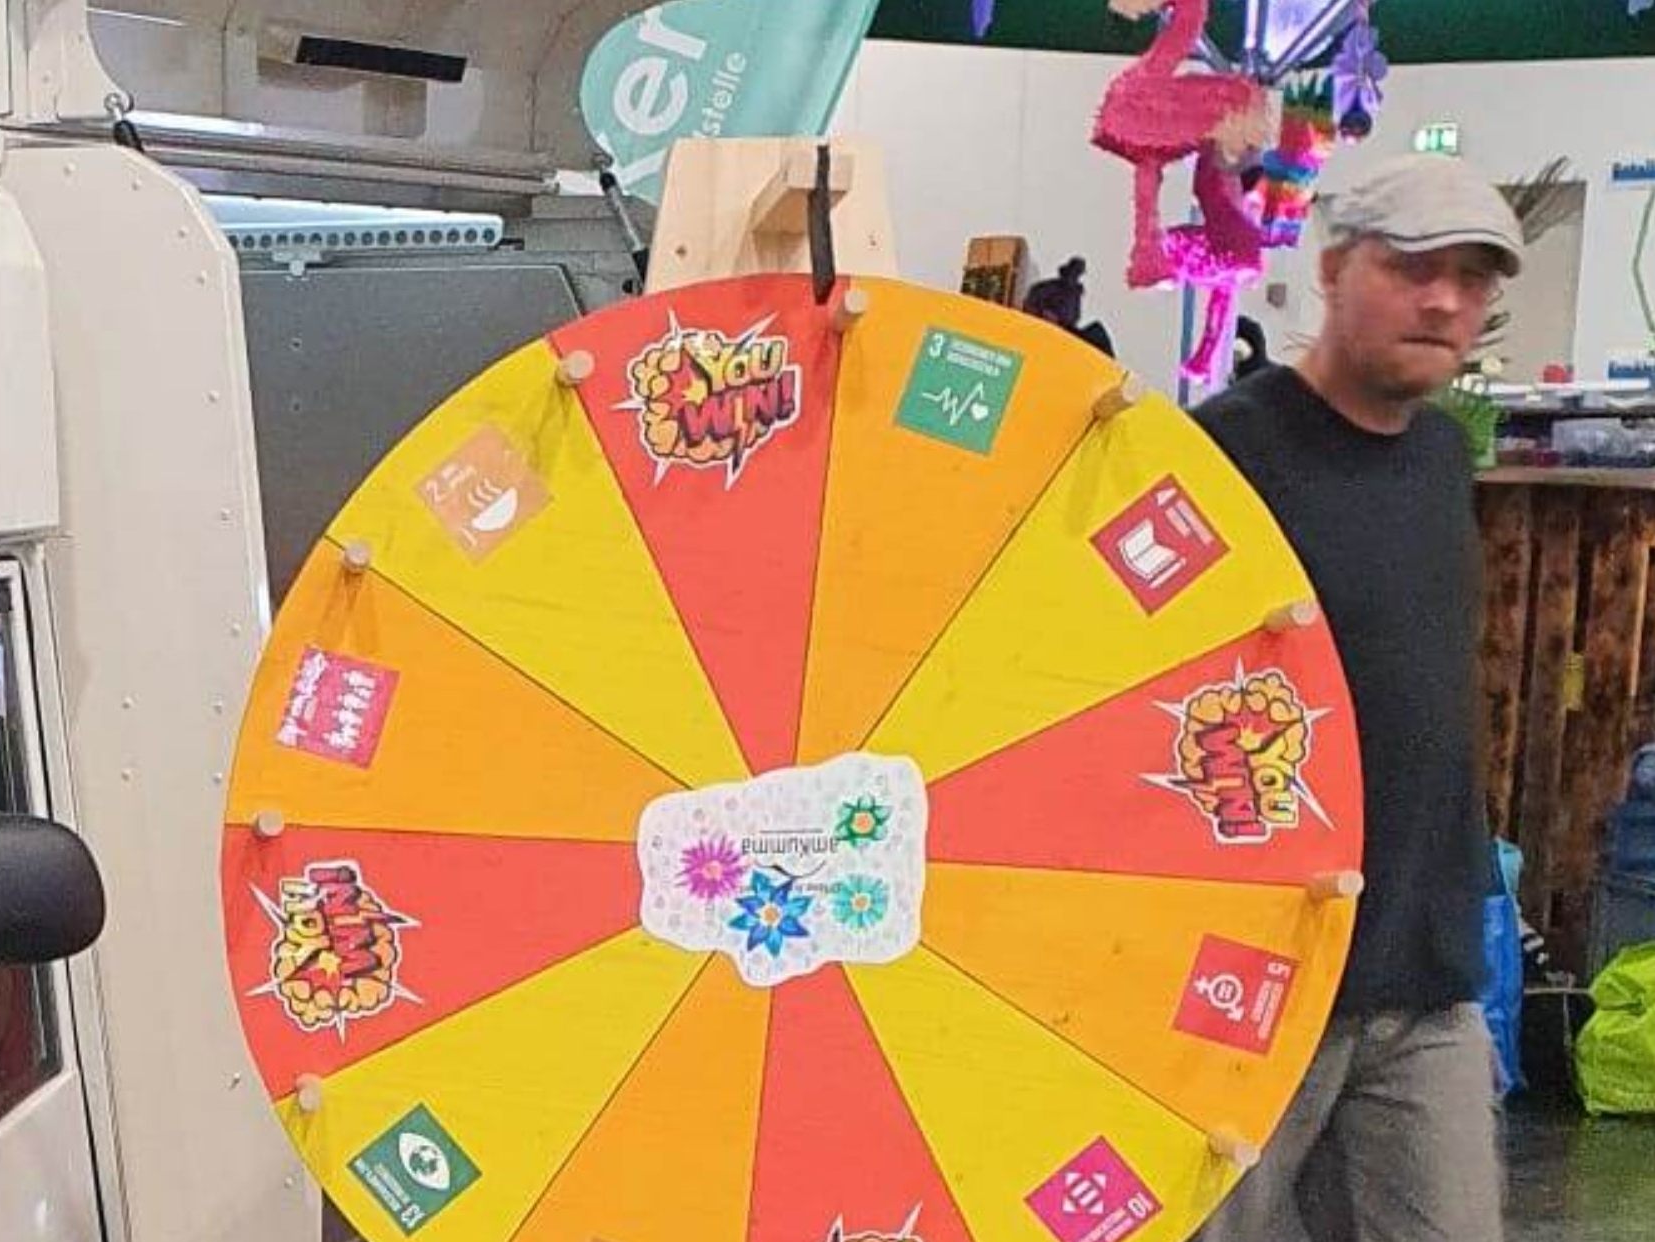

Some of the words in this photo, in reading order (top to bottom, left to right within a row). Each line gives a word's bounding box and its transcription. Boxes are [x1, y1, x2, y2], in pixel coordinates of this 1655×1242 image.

[929, 332, 944, 358] 3
[698, 340, 784, 391] YOU
[677, 369, 796, 447] WIN!
[1156, 487, 1177, 507] 4
[1249, 735, 1296, 823] YOU
[281, 879, 330, 964] YOU
[1267, 962, 1292, 979] 5
[400, 1202, 427, 1229] 13
[1126, 1191, 1154, 1219] 10
